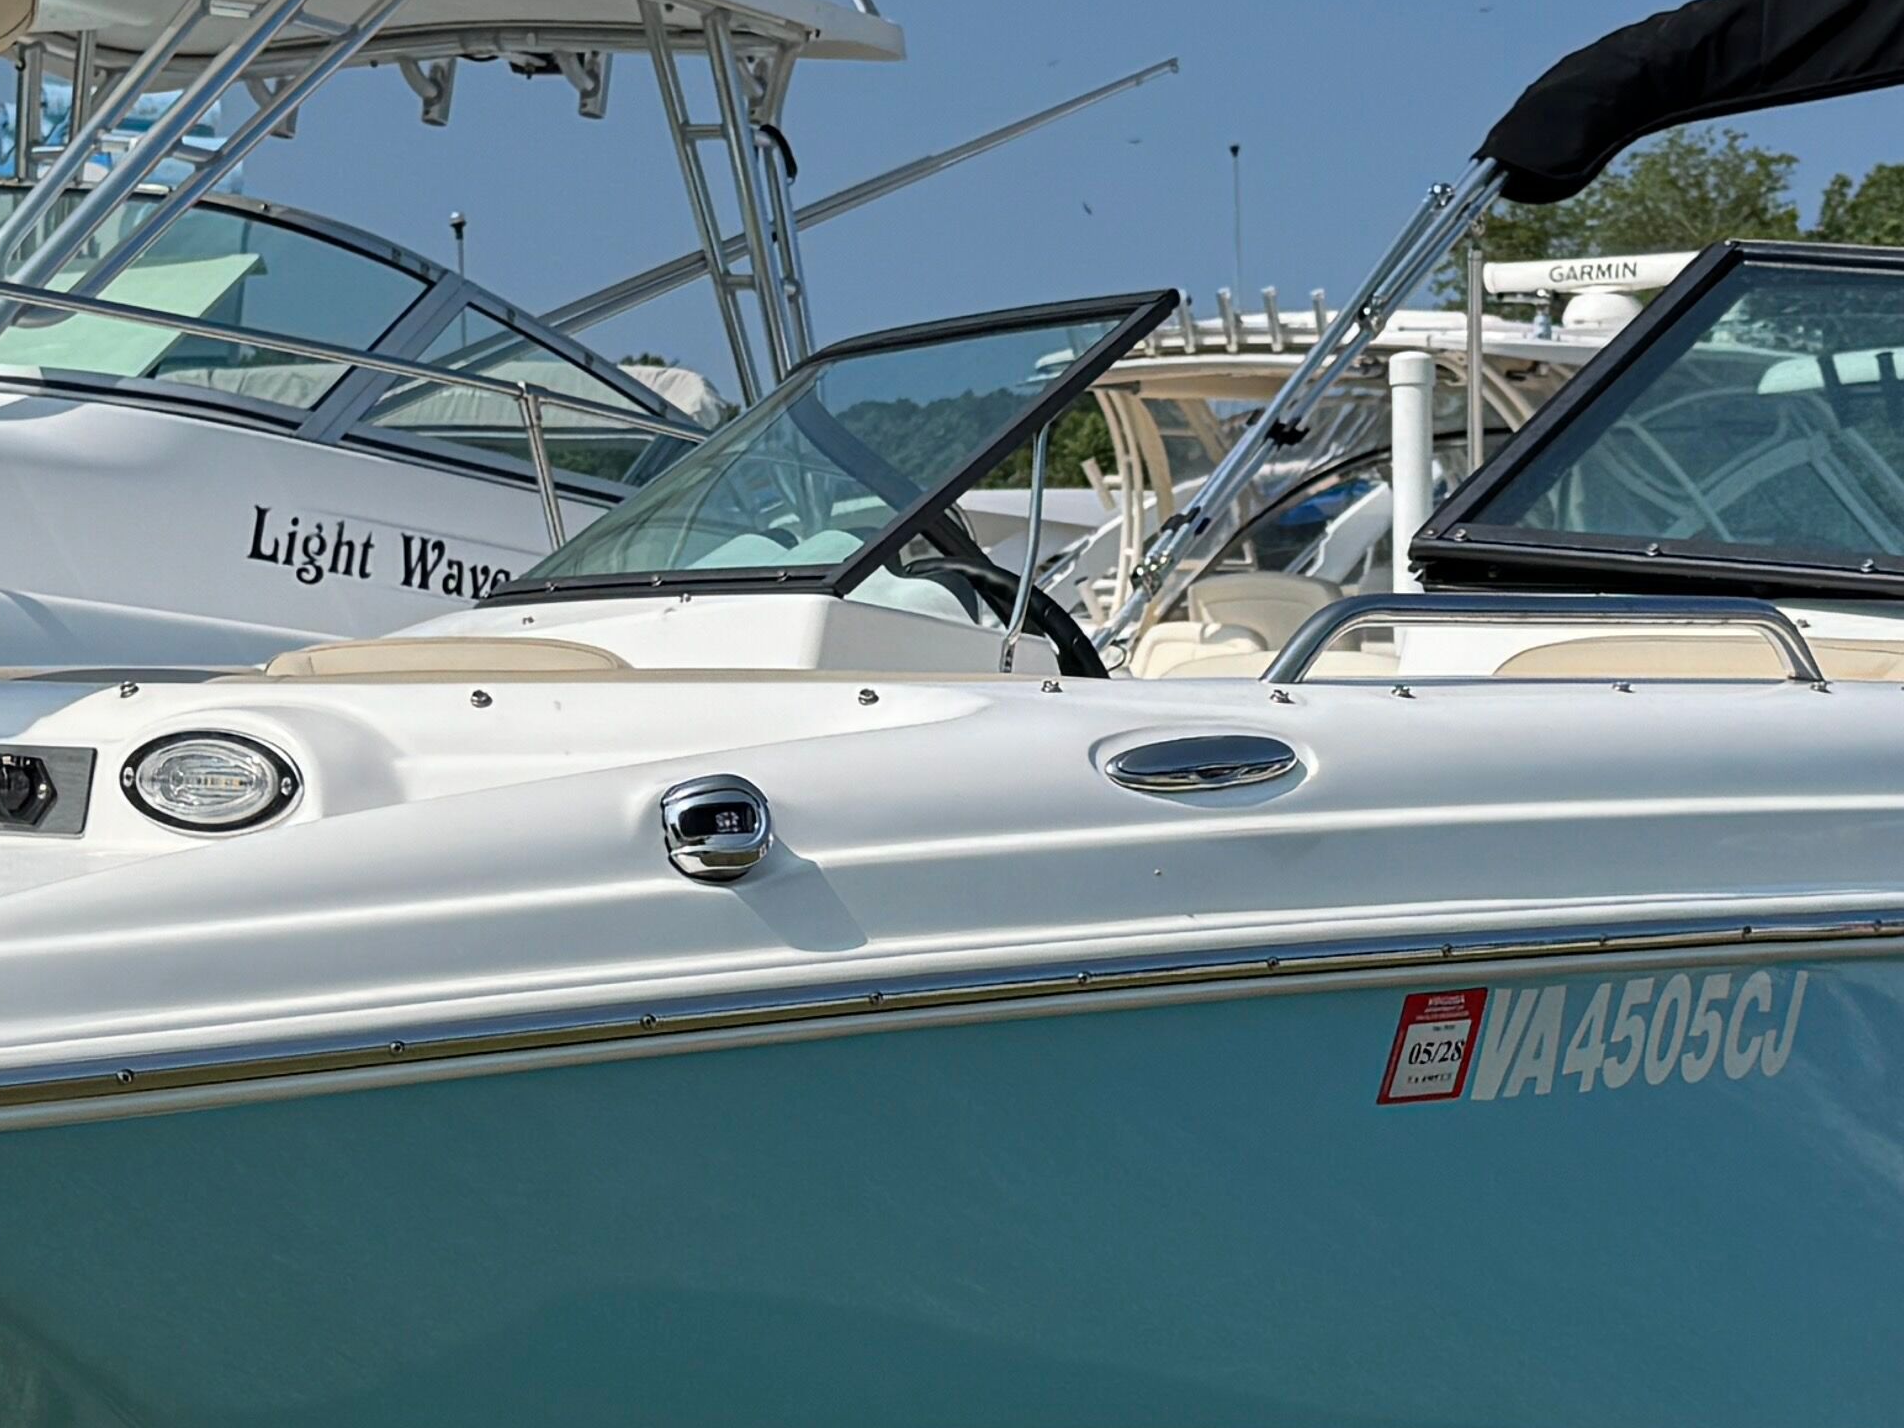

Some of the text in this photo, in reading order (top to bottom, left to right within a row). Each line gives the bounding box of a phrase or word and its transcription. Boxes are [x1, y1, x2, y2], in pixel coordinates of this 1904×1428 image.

[1548, 262, 1638, 284] GARMIN
[247, 504, 376, 585] Light
[1407, 1038, 1466, 1066] 05/28
[1469, 970, 1809, 1102] VA4505CJ
